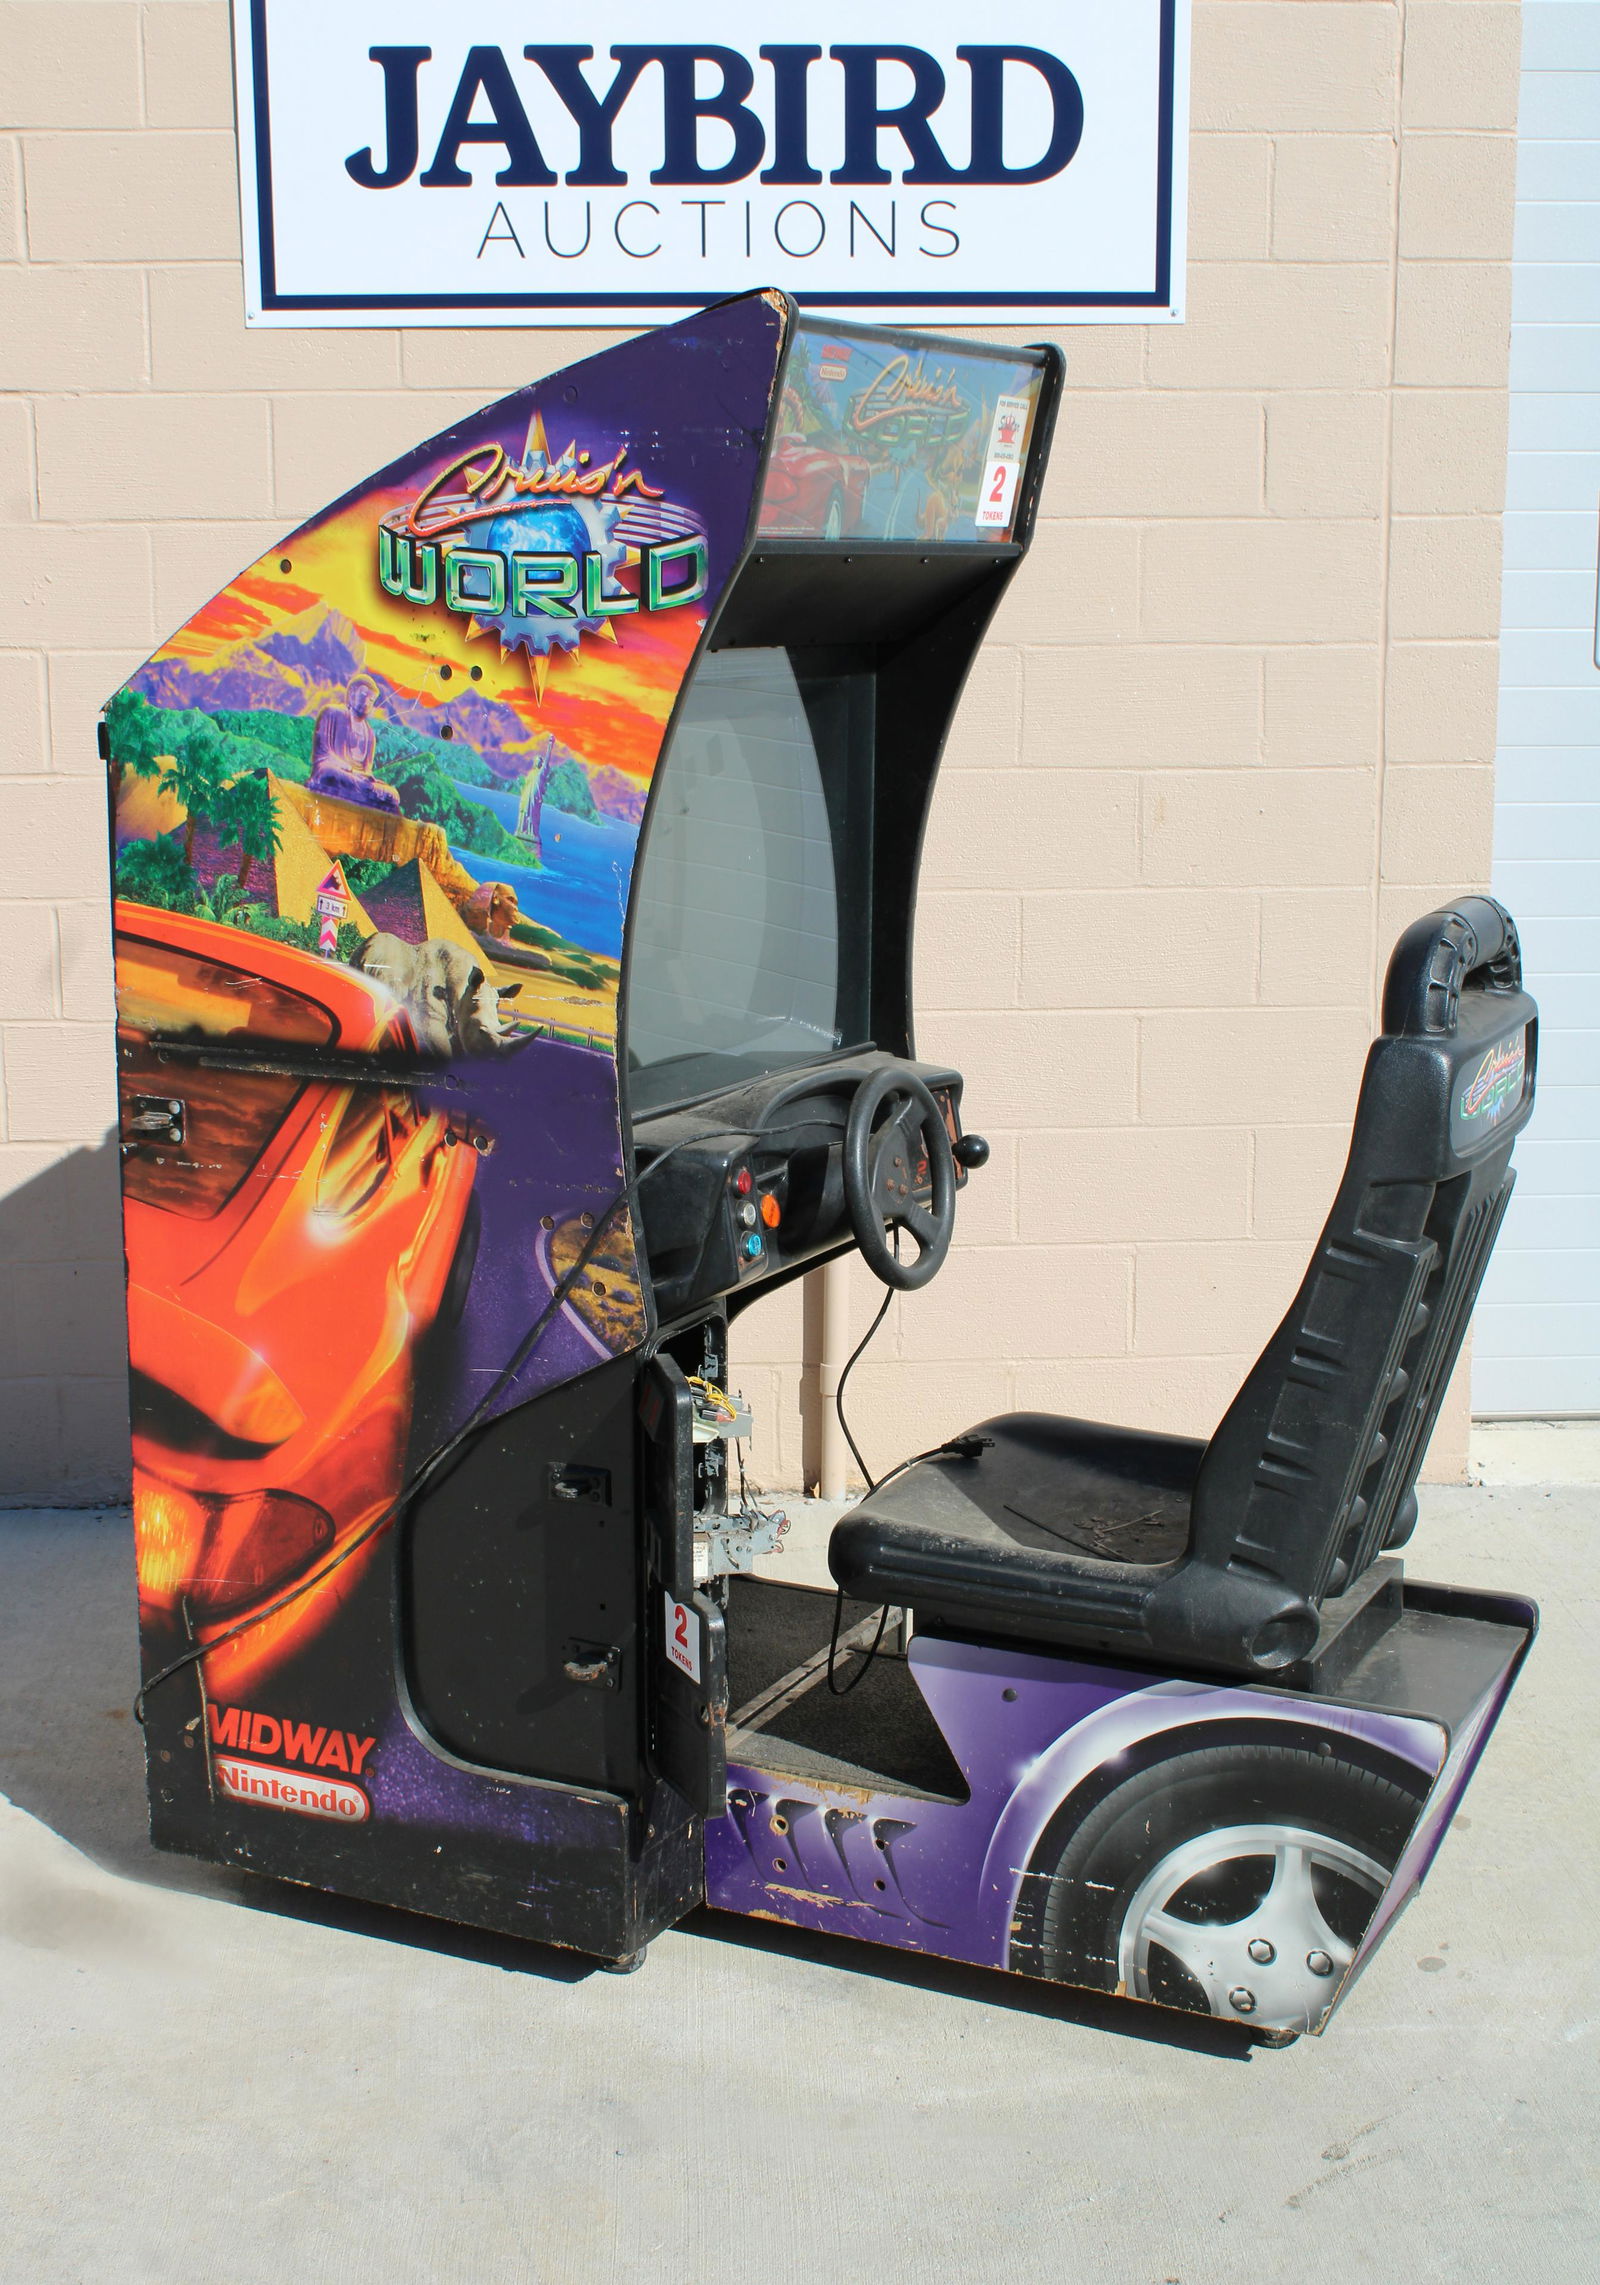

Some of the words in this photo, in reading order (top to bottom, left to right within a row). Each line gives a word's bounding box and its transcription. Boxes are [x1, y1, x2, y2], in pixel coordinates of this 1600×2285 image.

[344, 44, 1084, 190] JAYBIRD
[476, 200, 961, 260] AUCTIONS
[407, 443, 665, 538] Cruis'n
[989, 465, 1007, 502] 2
[983, 511, 1004, 521] TOKENS
[378, 524, 709, 619] WORLD
[326, 901, 331, 910] 3
[331, 903, 340, 912] km
[674, 1605, 688, 1648] 2
[671, 1646, 693, 1671] TOKENS
[206, 1703, 376, 1775] MIDWAY
[216, 1764, 358, 1816] Nintendo
